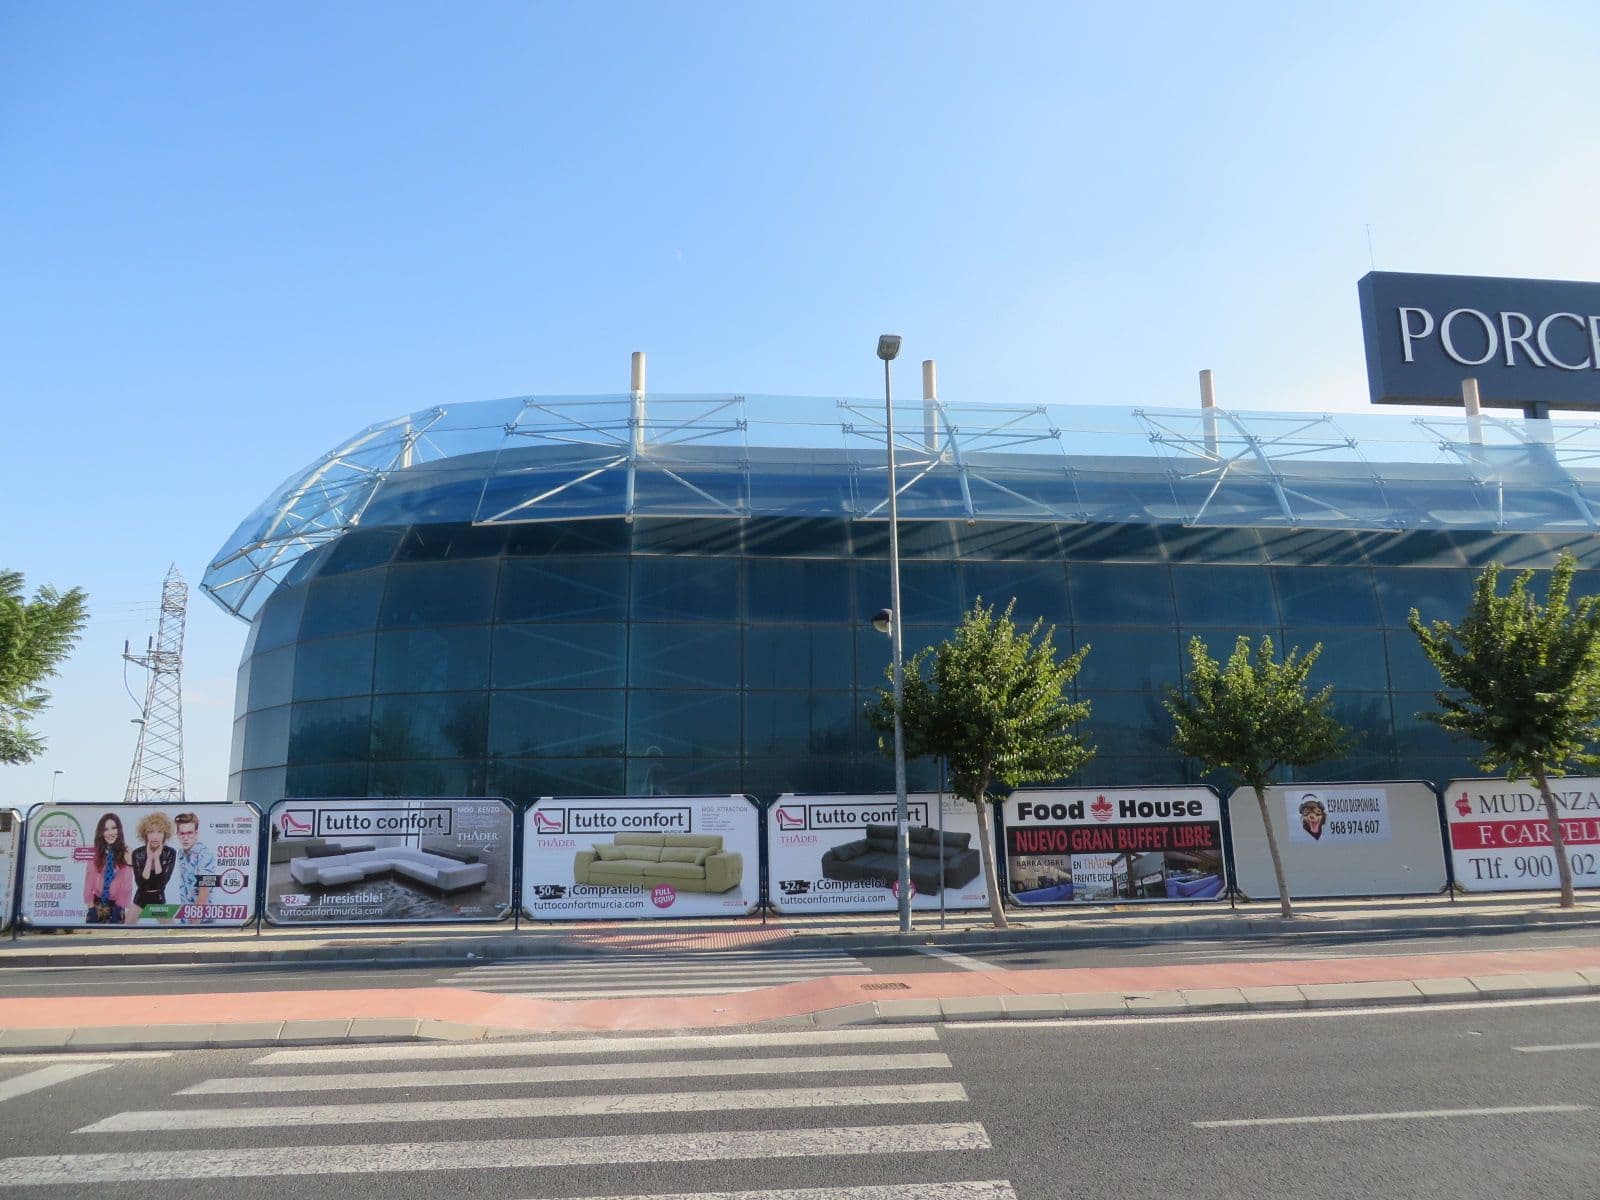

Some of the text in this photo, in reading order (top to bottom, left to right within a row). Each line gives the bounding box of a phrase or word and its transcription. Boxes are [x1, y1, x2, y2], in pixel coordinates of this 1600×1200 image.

[815, 807, 921, 824] tutto confrt
[1018, 799, 1203, 820] Food House
[327, 814, 371, 830] tutto
[376, 813, 443, 830] confort
[574, 813, 618, 828] tutto
[621, 812, 685, 827] confort
[1330, 819, 1380, 835] 968 974 607
[1015, 824, 1213, 852] NUEVO GRAN BUFFET LIBRE
[1478, 821, 1600, 845] F. CAREL
[216, 844, 251, 858] SESIÓN
[237, 859, 250, 867] UVA
[1073, 860, 1082, 870] EN
[1469, 857, 1509, 880] Tlf.
[1514, 855, 1553, 878] 900
[655, 887, 673, 897] FULL
[533, 900, 645, 910] tuttoconfortmurcia.com
[779, 895, 887, 906] tuttoconfortmurcia.com
[184, 906, 245, 919] 968 306 977
[279, 905, 384, 917] tuttoconfortmurcia.com
